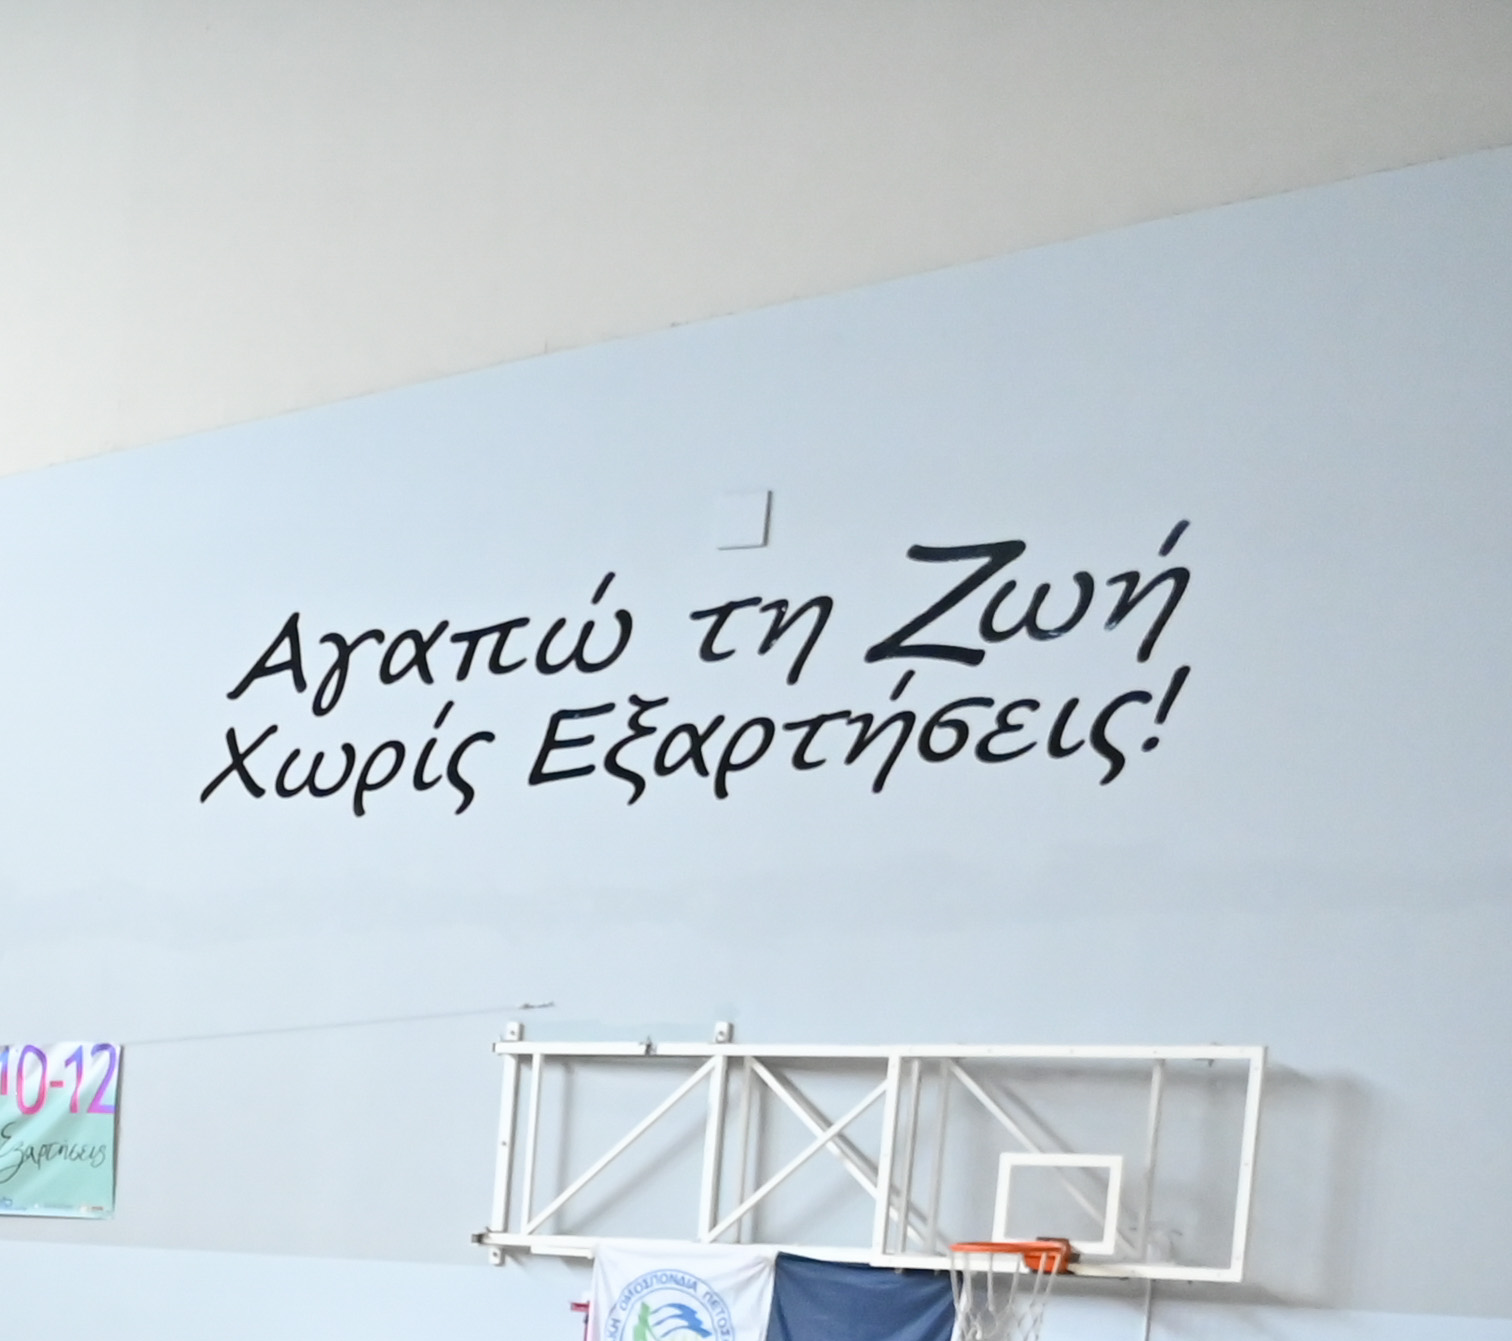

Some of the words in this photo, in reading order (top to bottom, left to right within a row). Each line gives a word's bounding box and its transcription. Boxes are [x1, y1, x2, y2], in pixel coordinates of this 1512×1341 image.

[227, 572, 633, 715] Αγαπώ
[690, 594, 835, 685] τη
[866, 519, 1191, 666] Ζωή
[200, 700, 496, 817] Χωρίς
[528, 666, 1191, 807] Εξαρτήσεις!
